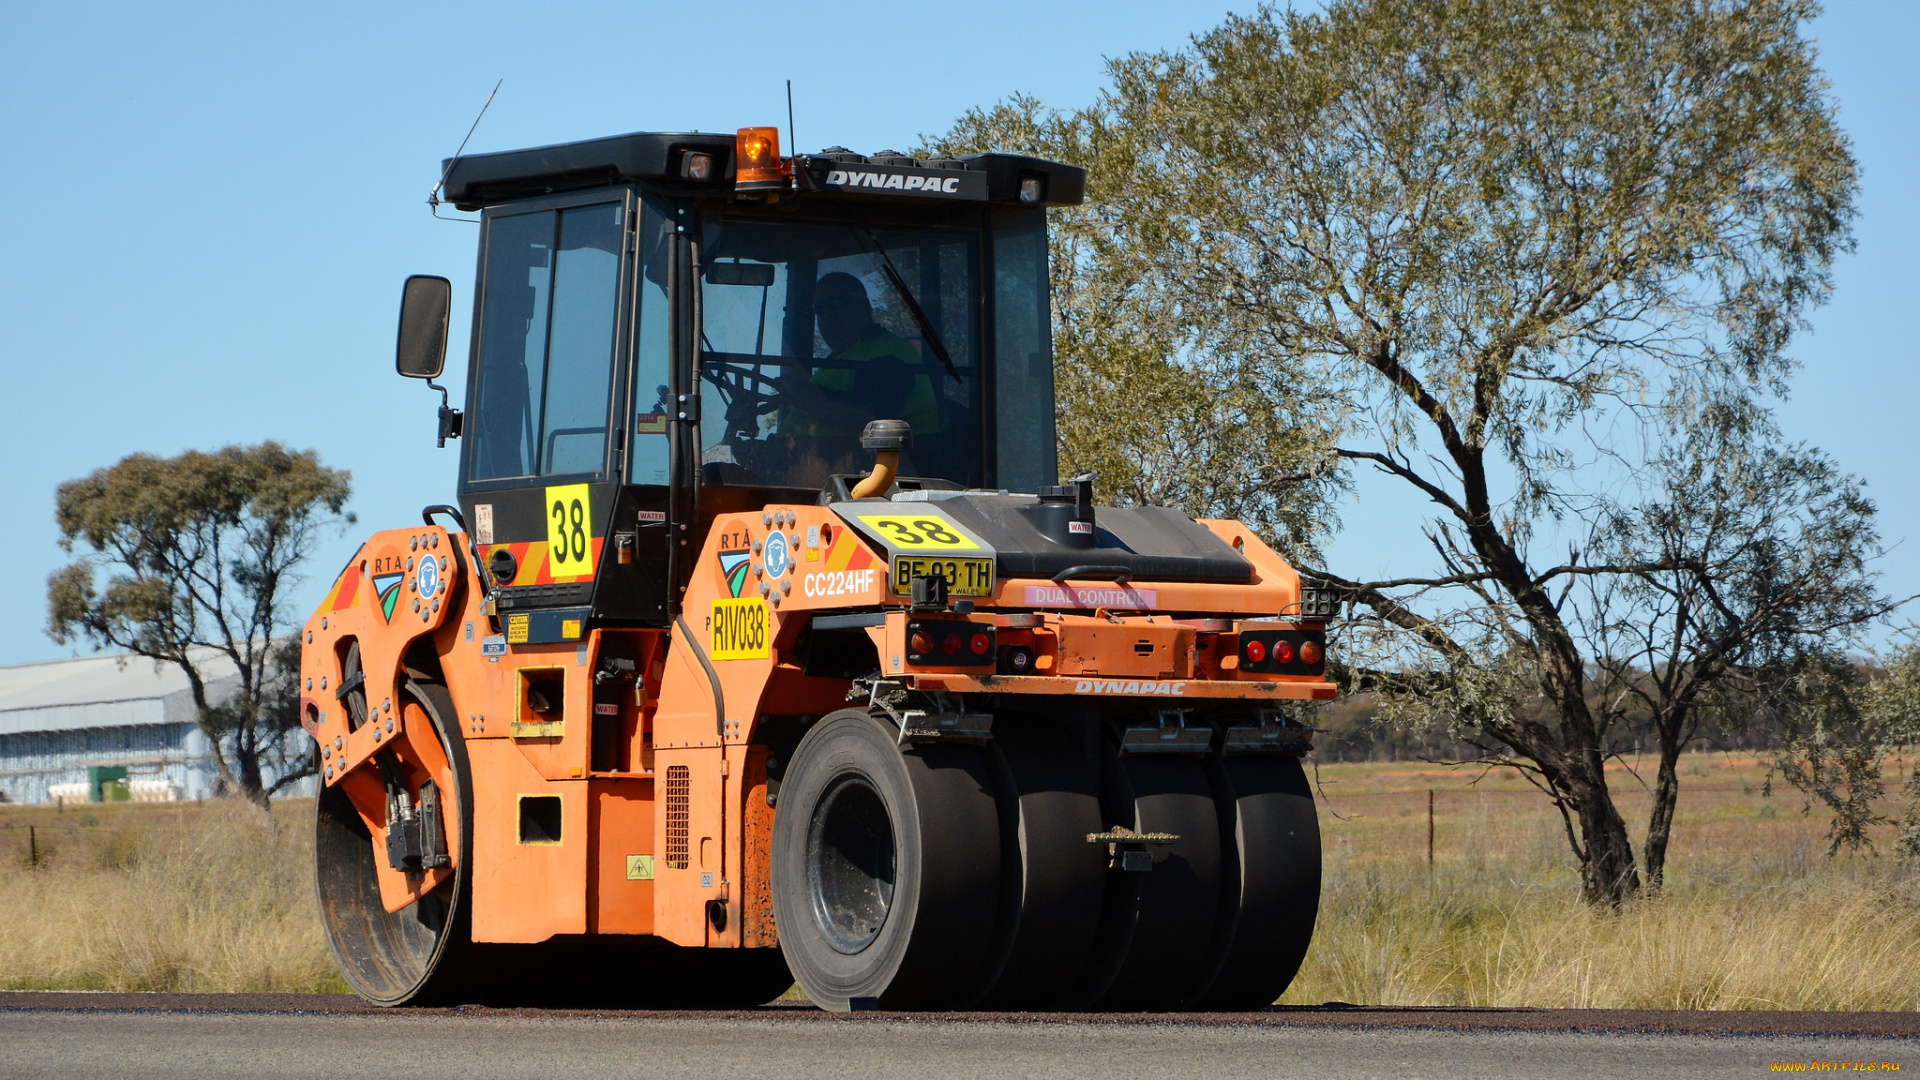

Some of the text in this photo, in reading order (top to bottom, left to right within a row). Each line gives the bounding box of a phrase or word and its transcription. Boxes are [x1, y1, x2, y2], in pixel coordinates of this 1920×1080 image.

[825, 170, 960, 193] DYNAPAC
[640, 512, 664, 520] WATER
[552, 498, 586, 564] 38
[877, 520, 961, 545] 38
[1071, 522, 1091, 532] WATER
[721, 530, 751, 550] RTA
[375, 556, 402, 573] RTA
[804, 569, 875, 598] CC224HF
[955, 587, 981, 595] WALES
[1035, 588, 1146, 606] DUAL CONTROL
[1075, 680, 1186, 696] DYNAPAC
[596, 705, 617, 714] WATER
